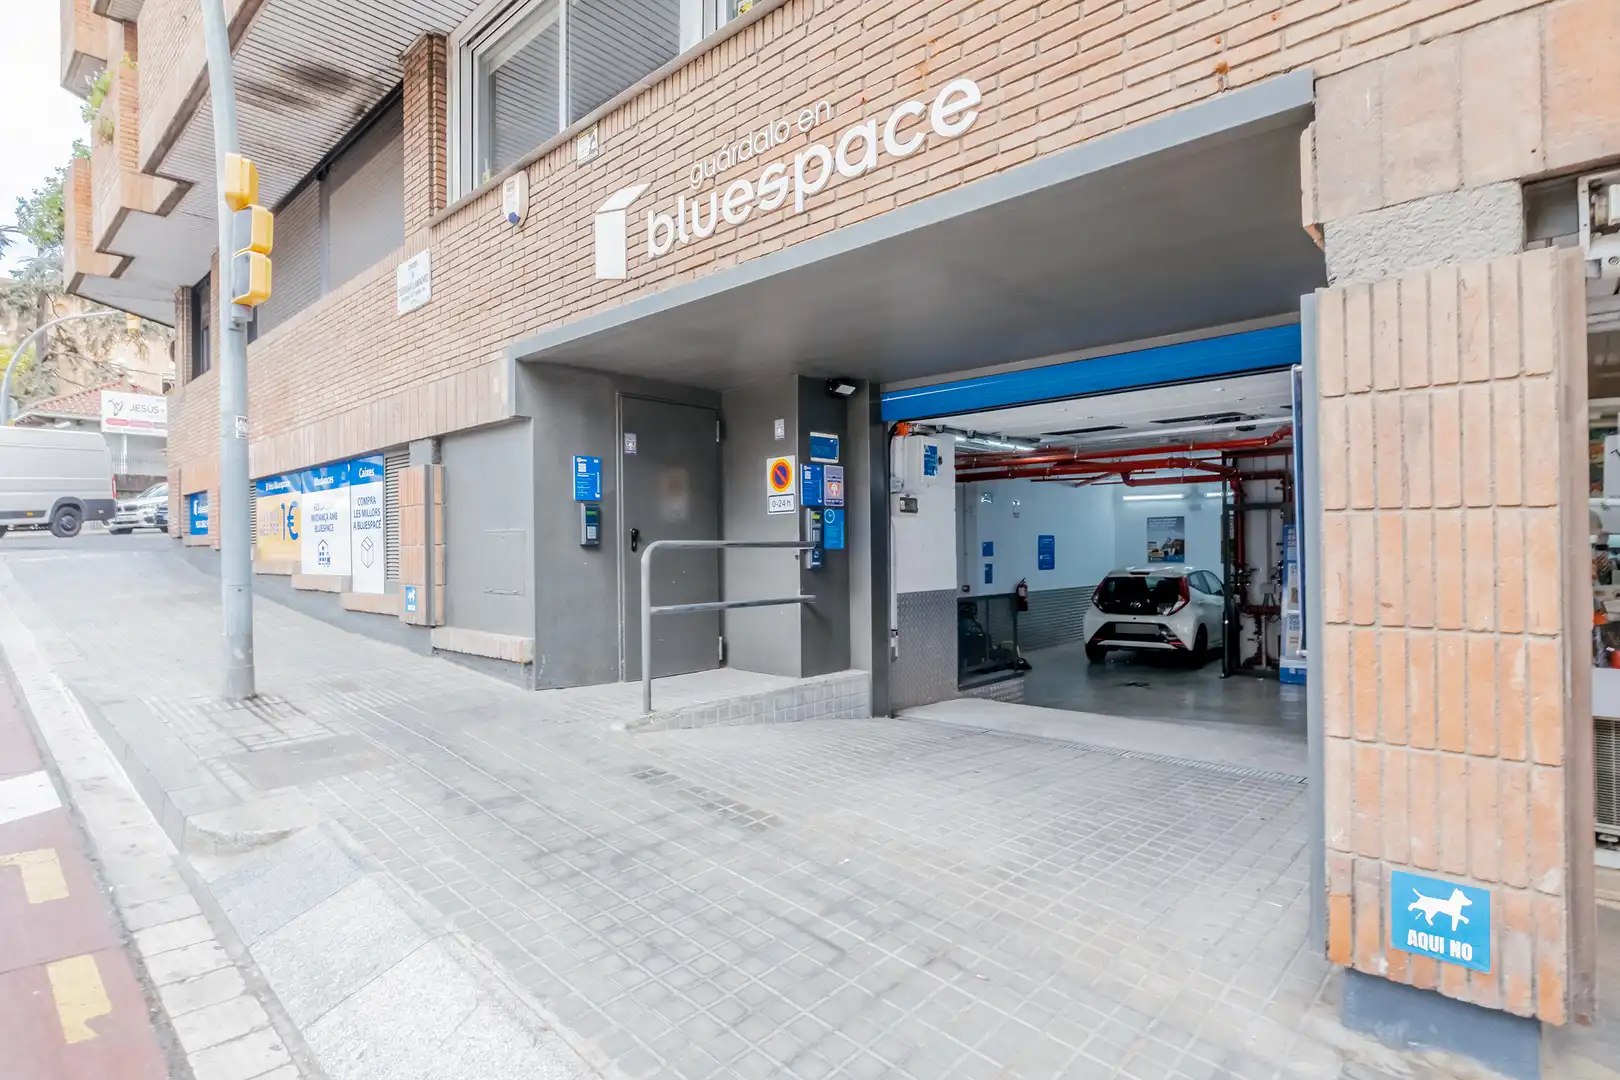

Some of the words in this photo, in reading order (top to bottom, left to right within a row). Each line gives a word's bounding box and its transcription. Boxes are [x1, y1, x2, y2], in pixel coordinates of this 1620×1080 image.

[690, 121, 790, 189] guárdalo
[798, 100, 831, 132] en
[647, 78, 982, 258] bluespace
[358, 467, 375, 478] Caixes
[357, 496, 376, 506] COMPRA
[362, 508, 380, 518] MILLORS
[314, 523, 335, 533] BLUESPACE
[353, 522, 357, 530] A
[1407, 928, 1445, 954] AQUI
[1449, 939, 1473, 961] NO
